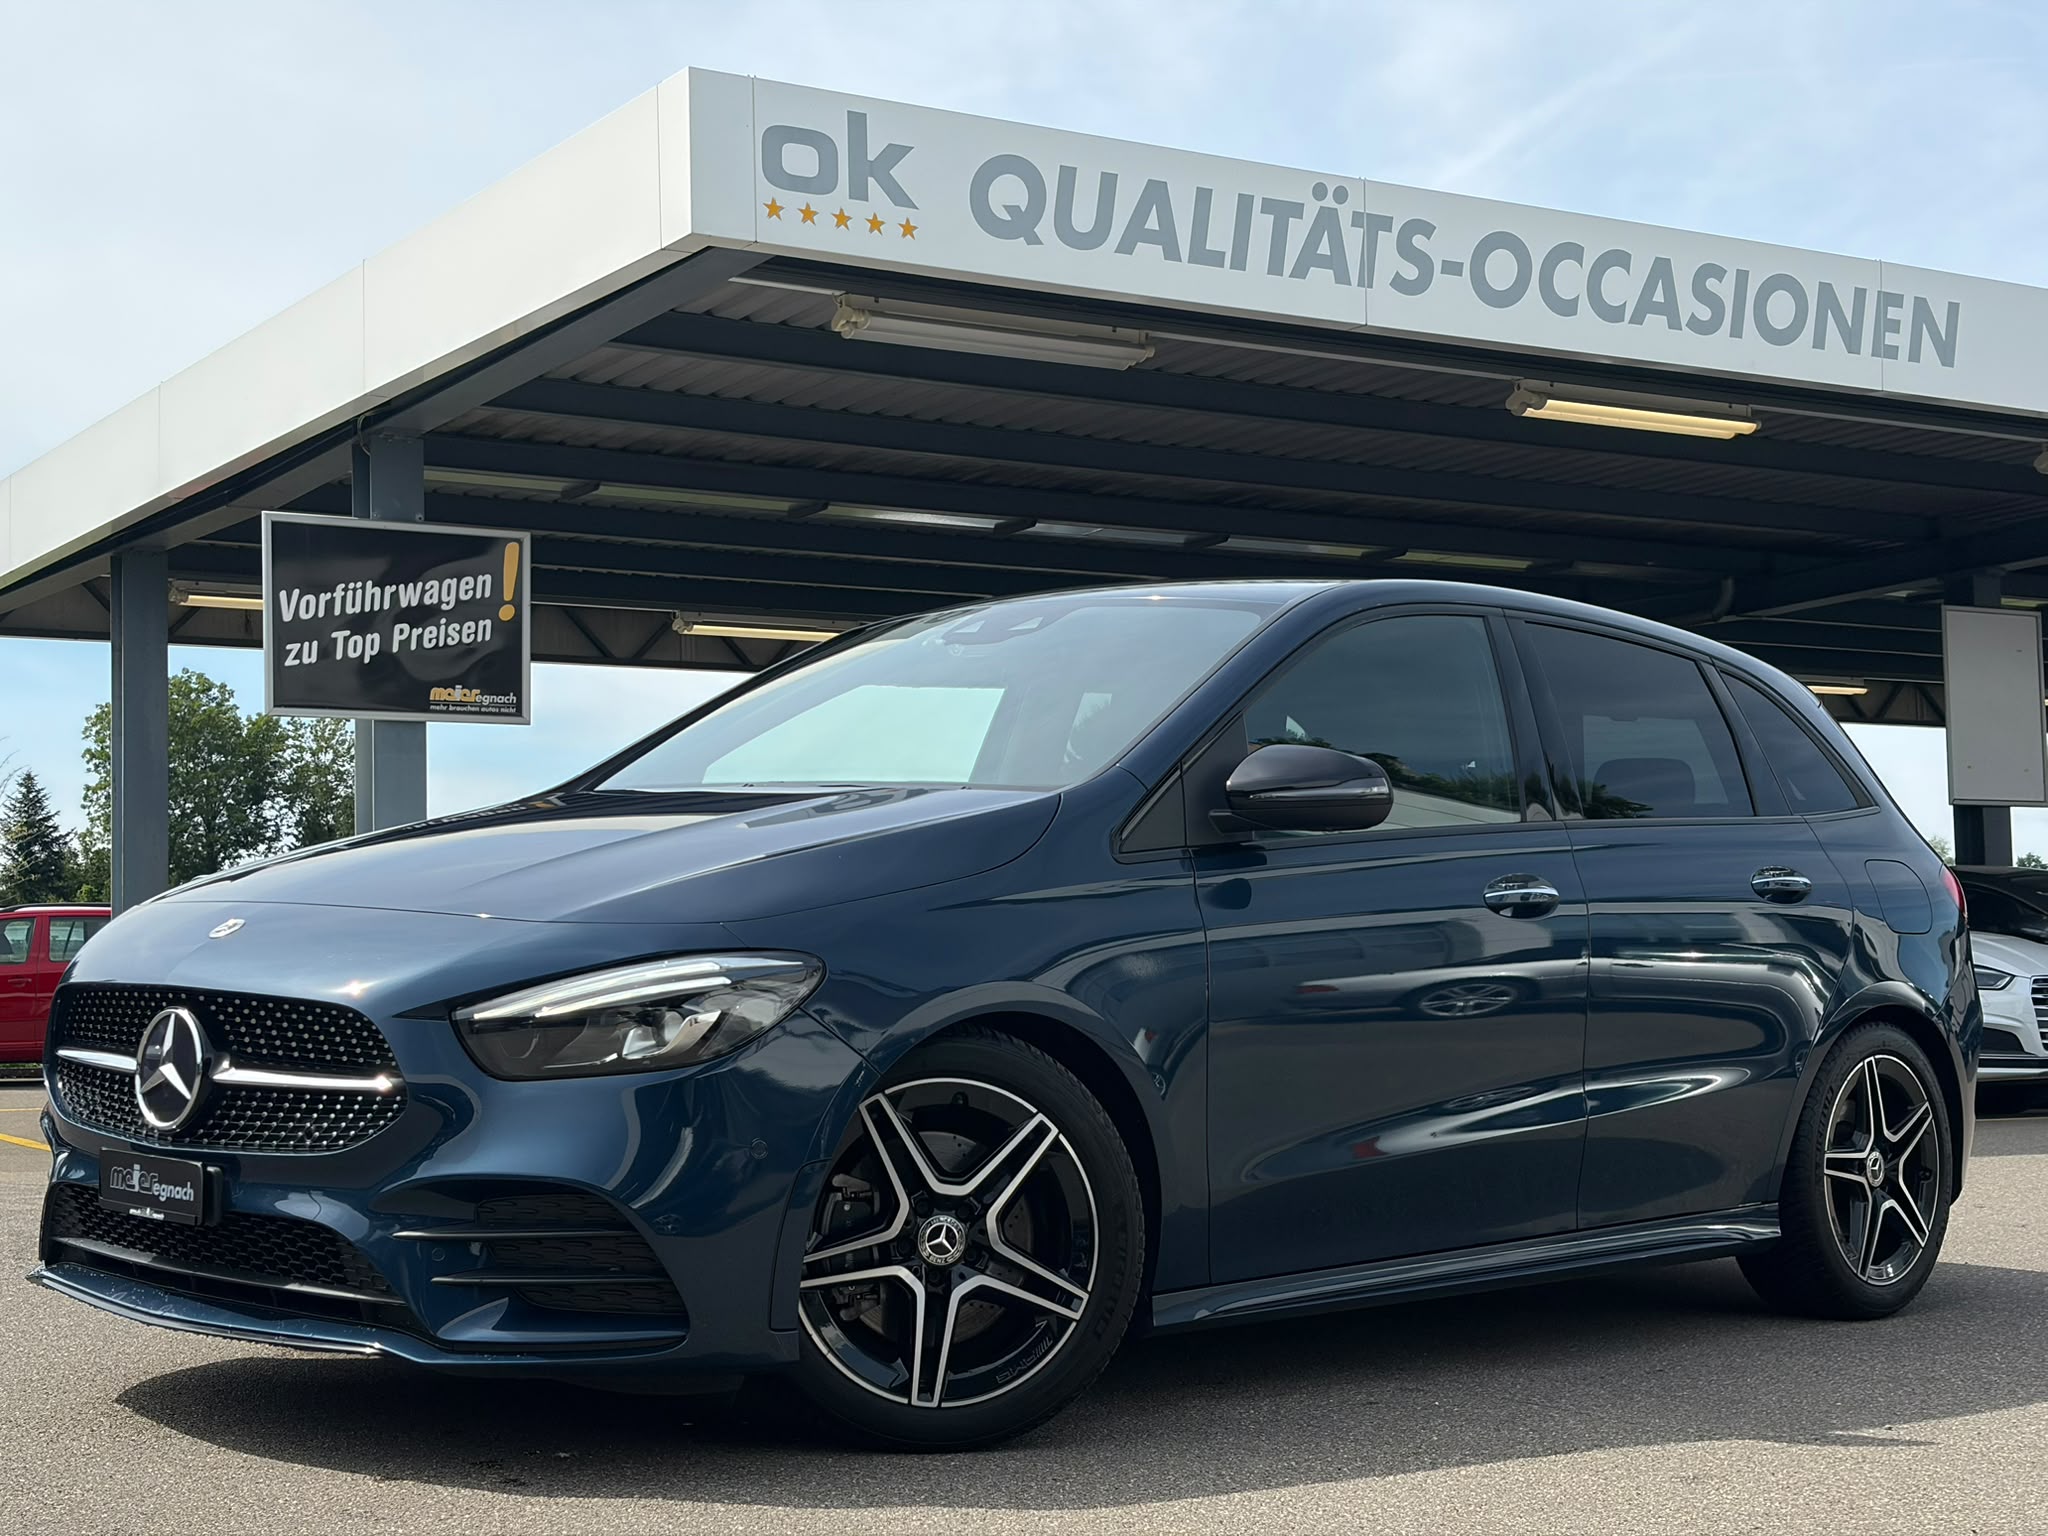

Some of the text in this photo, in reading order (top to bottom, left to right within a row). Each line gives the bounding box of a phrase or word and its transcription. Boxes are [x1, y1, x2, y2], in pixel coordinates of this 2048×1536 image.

[761, 109, 1961, 368] ok QUALITÄTS-OCCASIONEN
[279, 573, 492, 622] Vorführwagen
[284, 617, 492, 667] zu Top Preisen
[448, 704, 480, 712] brauchen
